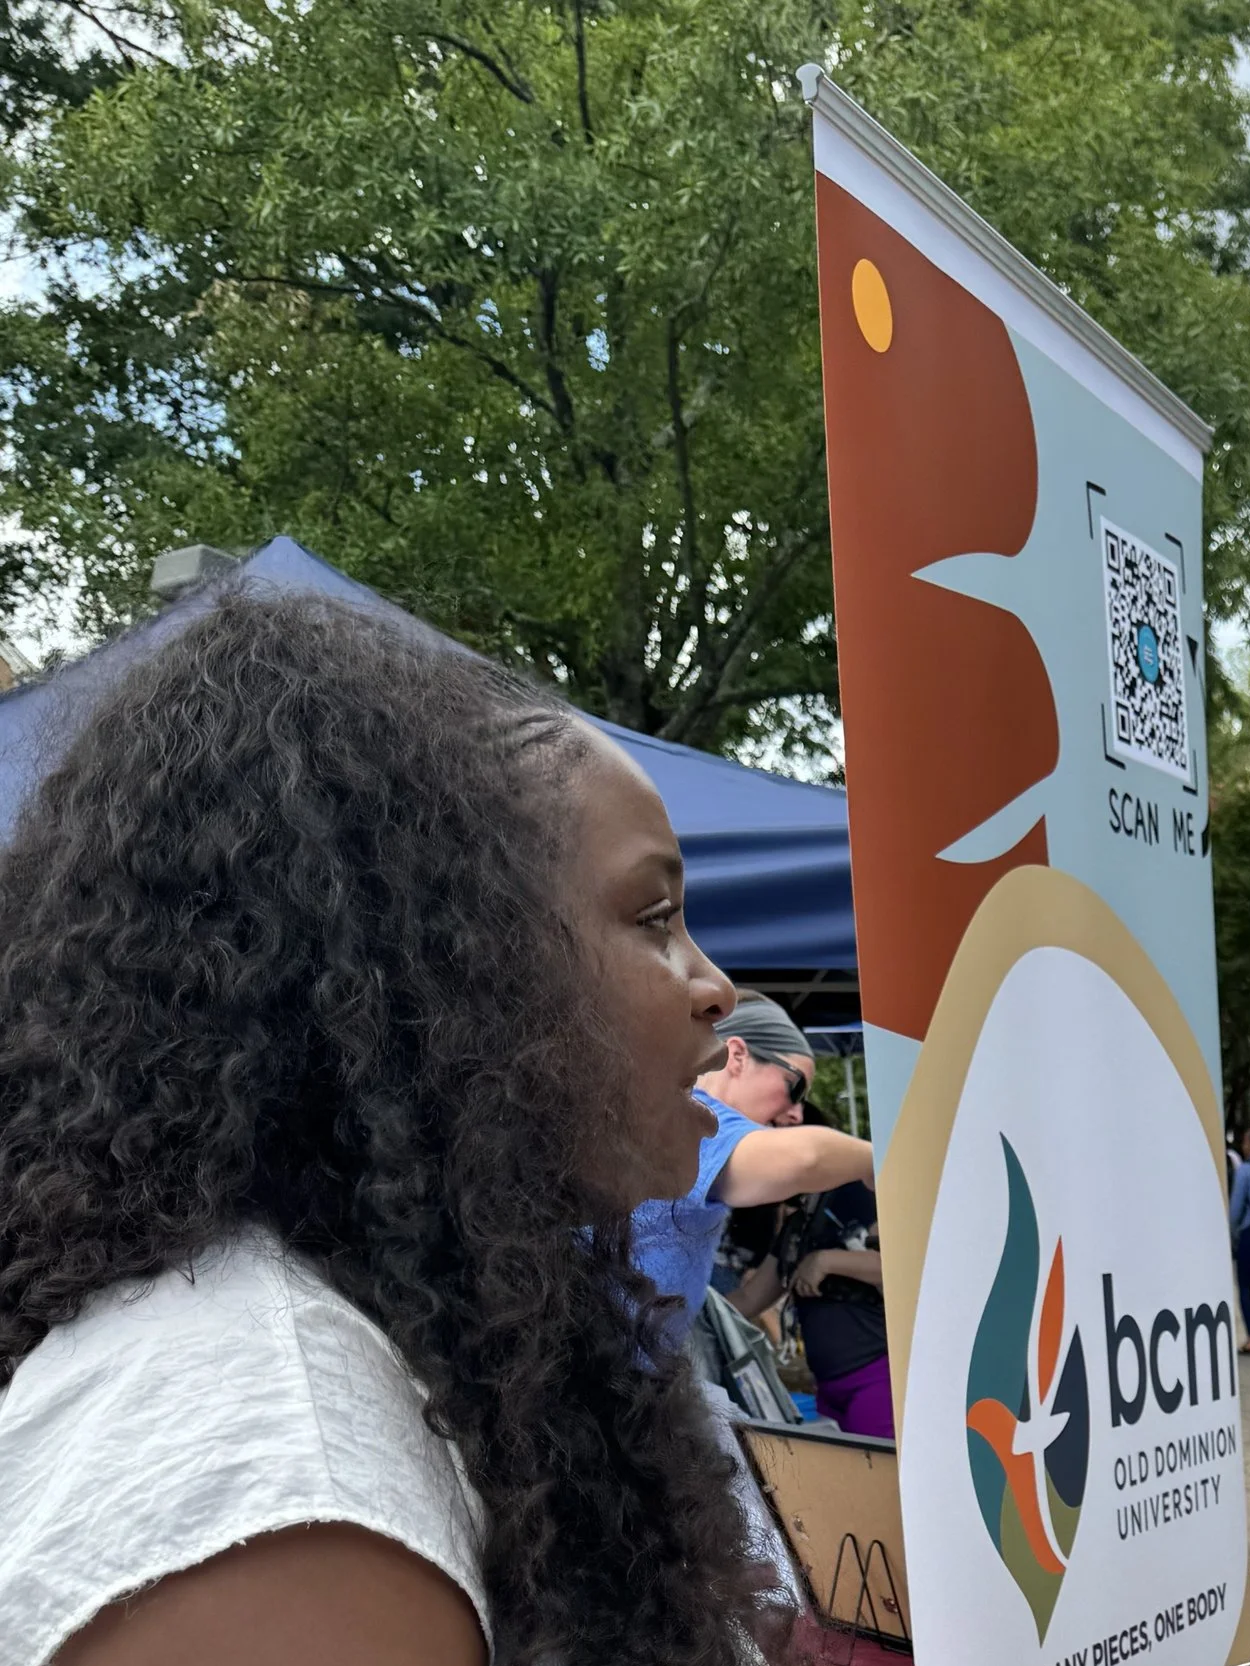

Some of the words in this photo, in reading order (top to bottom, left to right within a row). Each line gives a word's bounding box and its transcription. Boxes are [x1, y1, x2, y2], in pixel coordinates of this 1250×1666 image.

[1109, 787, 1159, 845] SCAN
[1173, 807, 1195, 856] ME
[1102, 1273, 1236, 1427] bcm
[1114, 1450, 1148, 1490] OLD
[1155, 1425, 1236, 1478] DOMINION
[1117, 1476, 1221, 1540] UNIVERSITY
[1154, 1606, 1185, 1644] ONE
[1187, 1583, 1227, 1634] BODY
